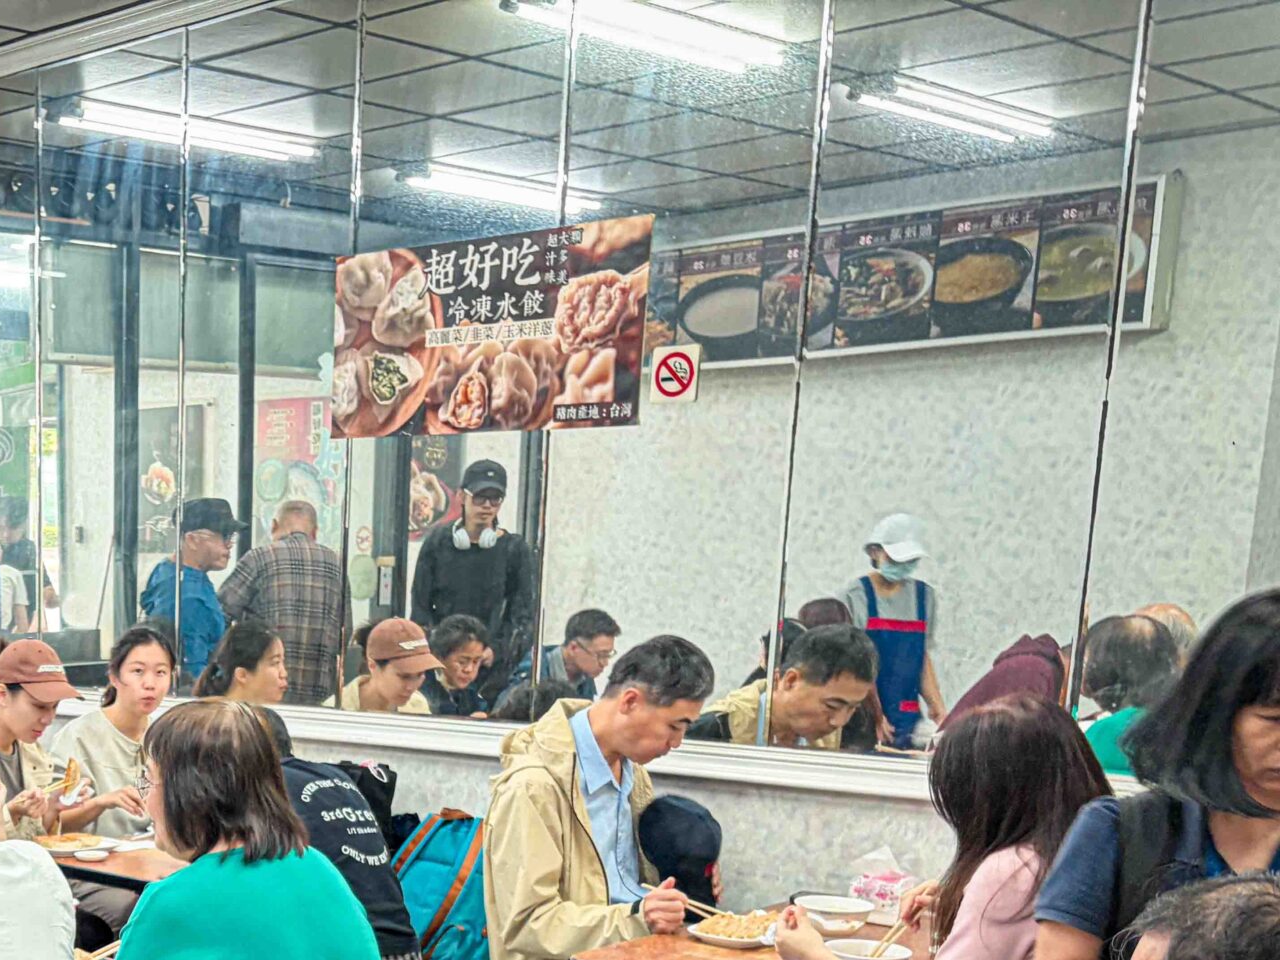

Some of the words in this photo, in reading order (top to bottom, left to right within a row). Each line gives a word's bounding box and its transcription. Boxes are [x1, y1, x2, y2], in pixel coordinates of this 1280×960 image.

[418, 237, 542, 299] 超好吃
[446, 290, 545, 325] 冷凍水餃
[301, 782, 320, 802] OVER
[341, 845, 366, 864] ONLY
